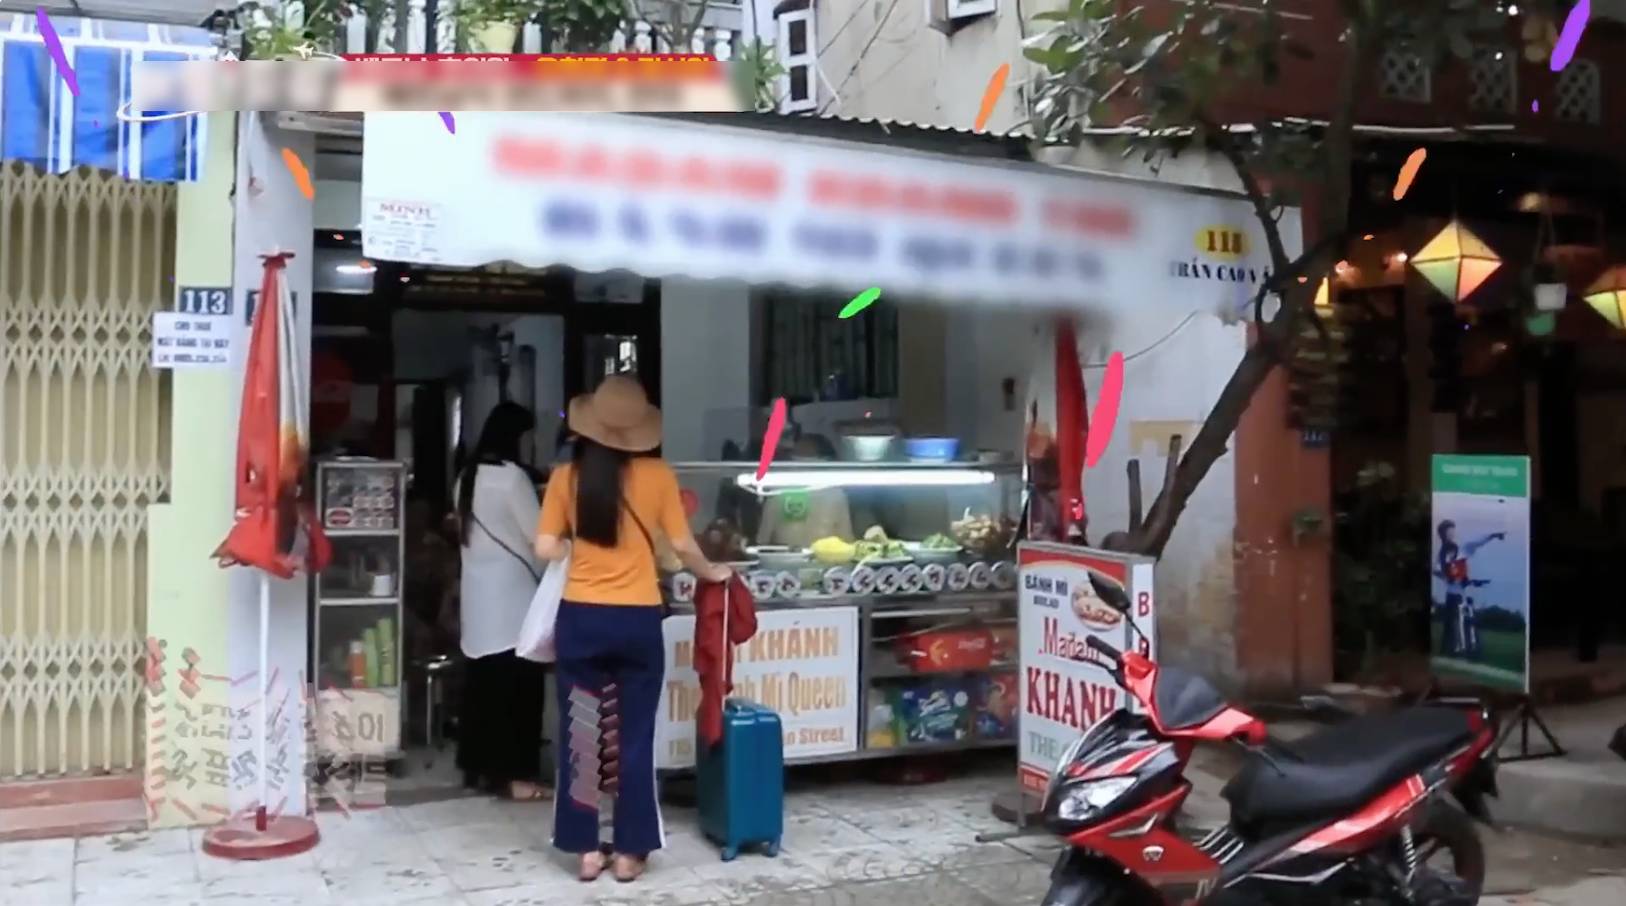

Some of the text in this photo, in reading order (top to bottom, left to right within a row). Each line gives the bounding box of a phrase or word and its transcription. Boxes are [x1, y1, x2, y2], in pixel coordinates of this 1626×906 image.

[184, 290, 226, 314] 113
[750, 620, 839, 662] KHÁNH
[787, 671, 847, 716] Queen
[798, 726, 844, 746] Street
